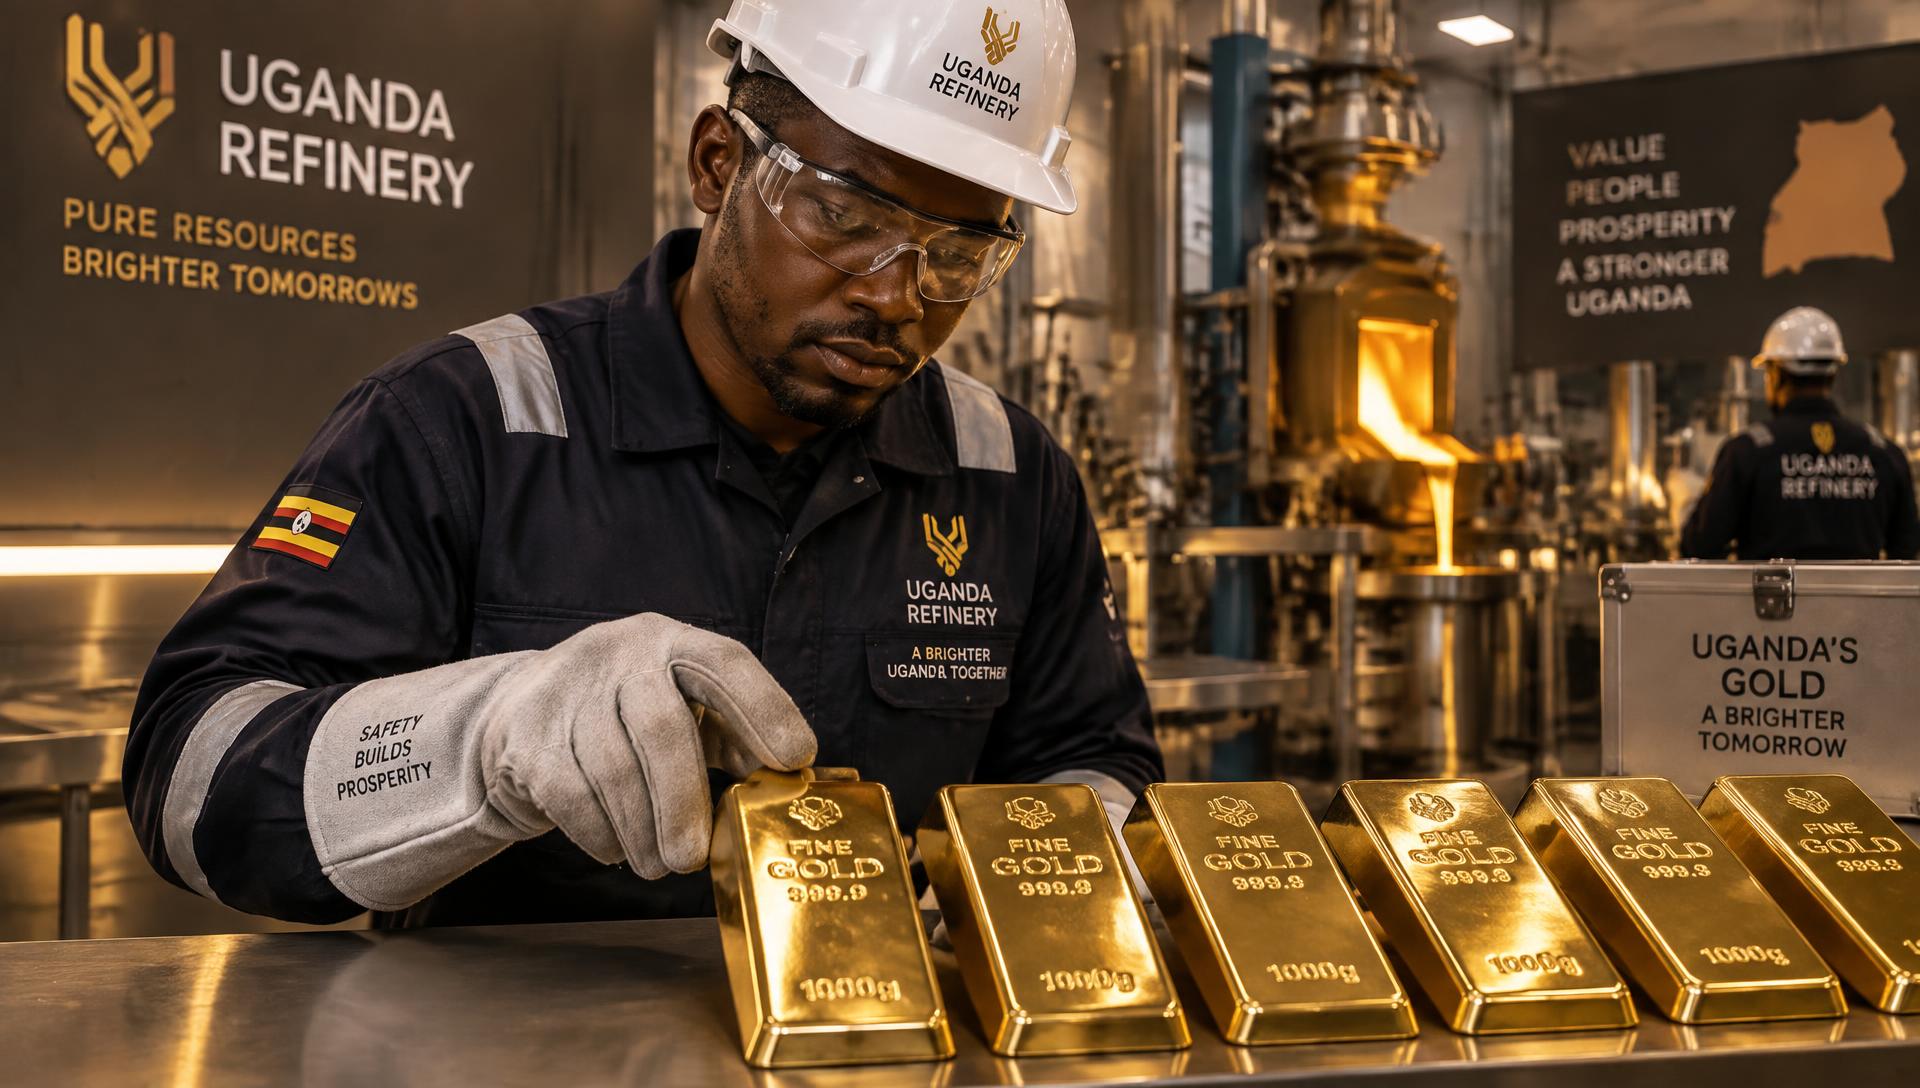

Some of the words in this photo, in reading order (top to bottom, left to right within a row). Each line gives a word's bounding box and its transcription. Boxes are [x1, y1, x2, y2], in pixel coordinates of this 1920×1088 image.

[942, 53, 1021, 101] UGANDA
[220, 49, 456, 141] UGANDA
[929, 73, 1019, 121] REFINERY
[1568, 133, 1666, 169] VALUE
[220, 121, 473, 209] REFINERY
[1567, 171, 1680, 206] PEOPLE
[64, 198, 158, 238] PURE
[174, 212, 357, 263] RESOURCES
[1560, 206, 1736, 245] PROSPERITY
[63, 245, 219, 290] BRIGHTER
[230, 264, 418, 309] TOMORROWS
[1556, 258, 1578, 285] A
[1584, 247, 1729, 282] STRONGER
[1567, 283, 1692, 317] UGANDA
[1781, 453, 1875, 477] UGANDA
[906, 579, 993, 602] UGANDA
[907, 604, 998, 626] REFINERY
[912, 647, 922, 660] A
[926, 647, 991, 662] BRIGHTER
[1693, 633, 1858, 664] UGANDA'S
[951, 665, 1007, 680] TOGETHER
[1721, 667, 1825, 699] GOLD
[360, 714, 424, 742] SAFETY
[1701, 705, 1717, 724] A
[1725, 706, 1845, 731] BRIGHTER
[1698, 731, 1847, 758] TOMORROW
[1615, 827, 1678, 841] FINE
[1802, 822, 1863, 835] FINE
[788, 839, 853, 856] FINE
[1008, 837, 1072, 853] FINE
[1216, 834, 1281, 849] FINE
[1611, 841, 1714, 860] GOLD
[1799, 836, 1902, 855] GOLD
[991, 854, 1104, 877] GOLD
[1203, 851, 1314, 872] GOLD
[1408, 847, 1518, 865] GOLD
[768, 857, 884, 880] GOLD
[1700, 944, 1790, 966] 1000g
[1266, 961, 1361, 984] 1000g
